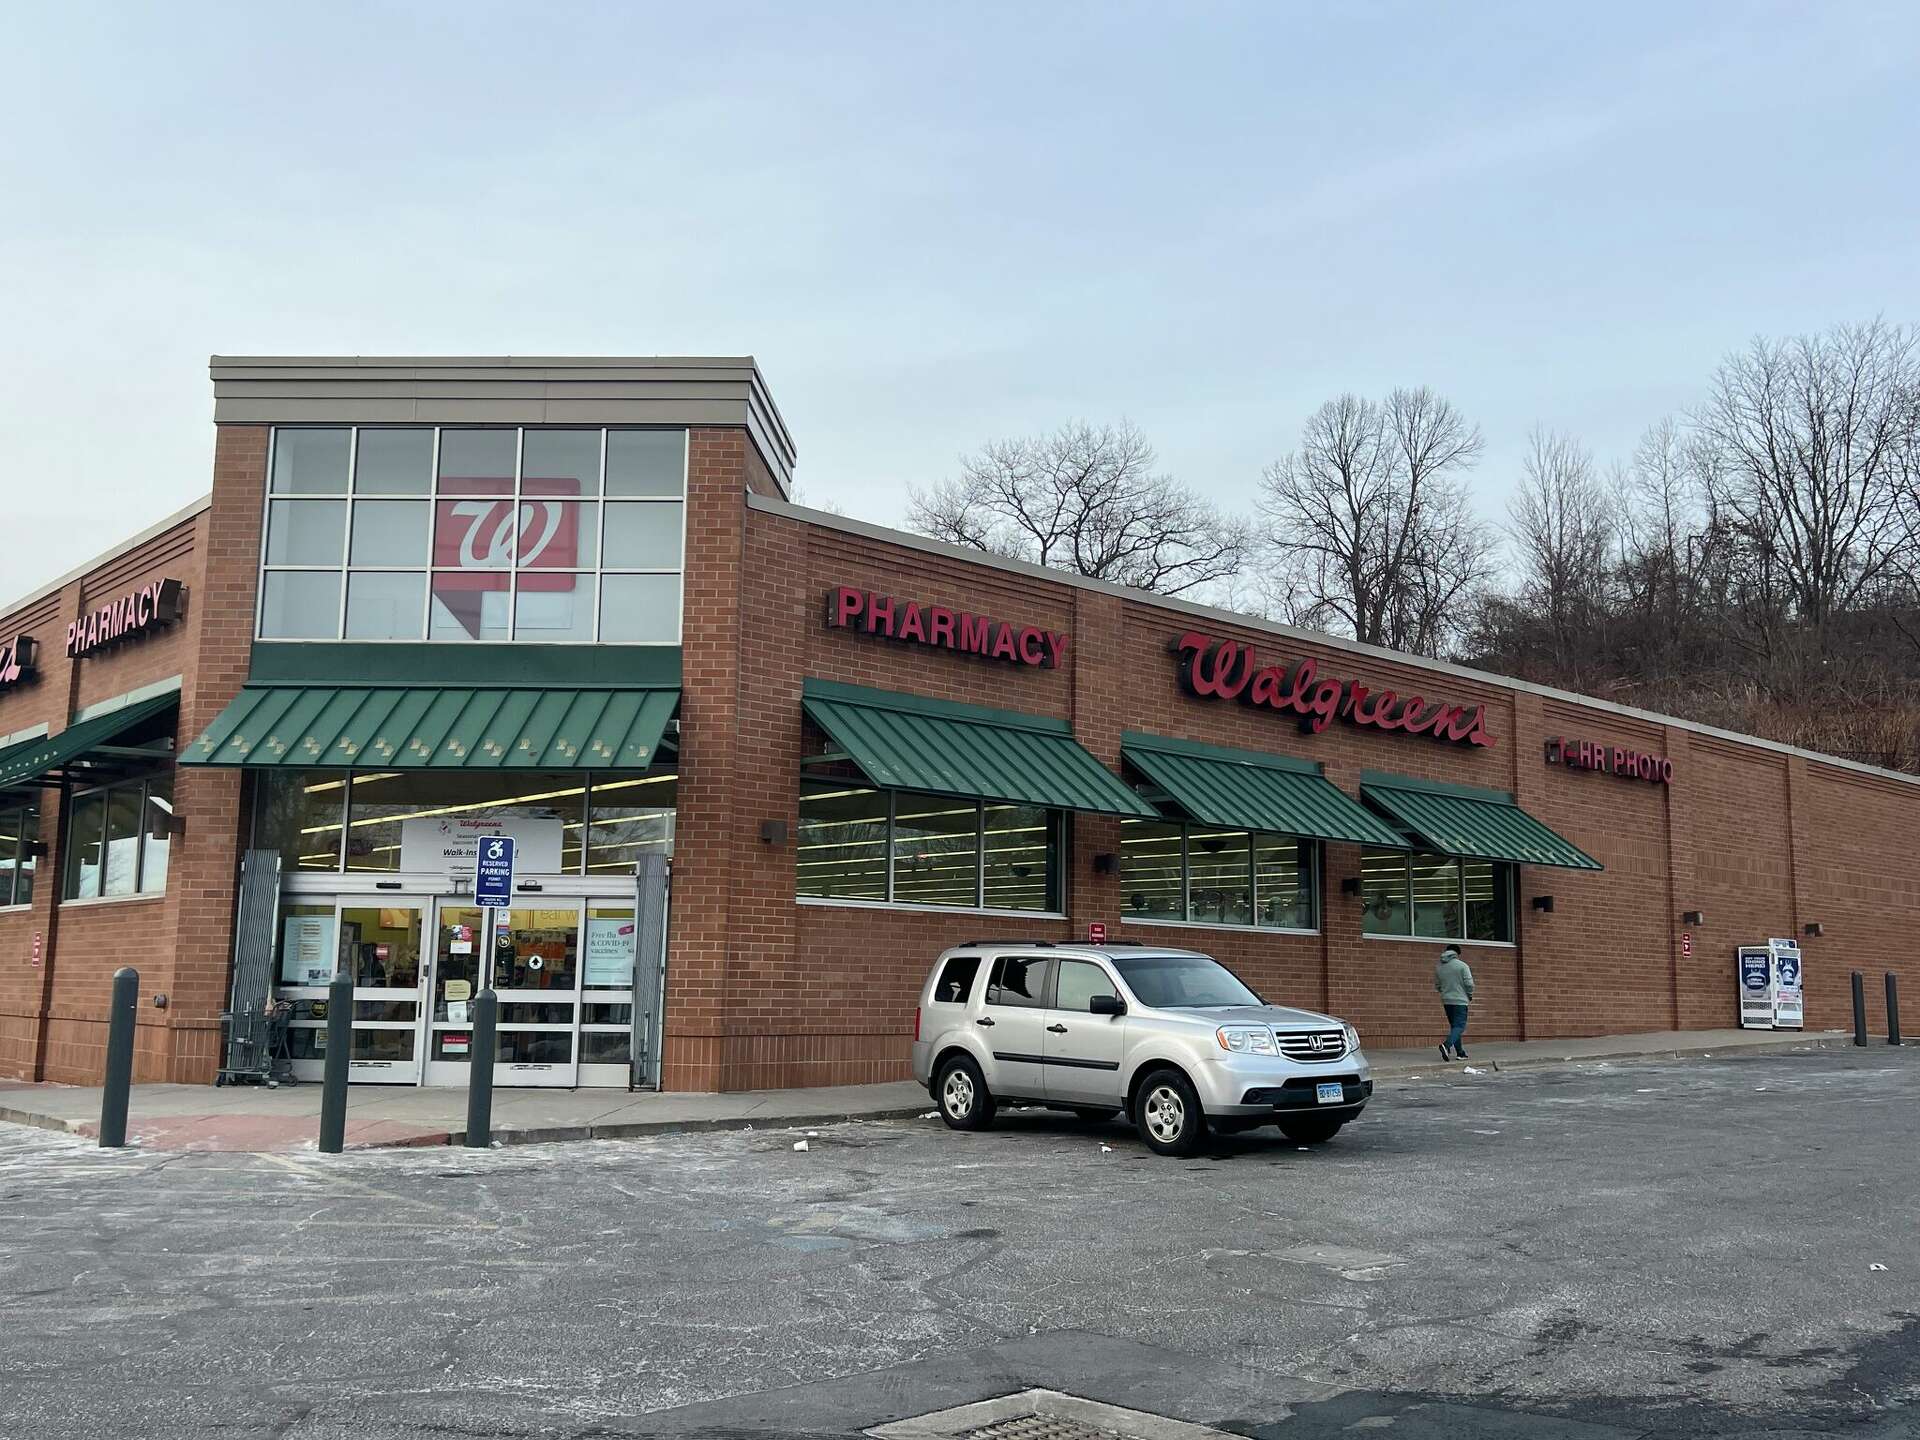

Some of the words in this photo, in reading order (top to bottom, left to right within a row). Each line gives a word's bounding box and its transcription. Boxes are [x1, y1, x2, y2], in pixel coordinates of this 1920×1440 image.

[66, 577, 167, 658] PHARMACY
[837, 585, 1070, 669] PHARMACY
[1177, 630, 1497, 749] Walgreens
[1558, 735, 1606, 771] 1-HR
[1613, 746, 1674, 784] PHOTO
[459, 820, 503, 830] Walgreens
[480, 867, 510, 876] PARKING
